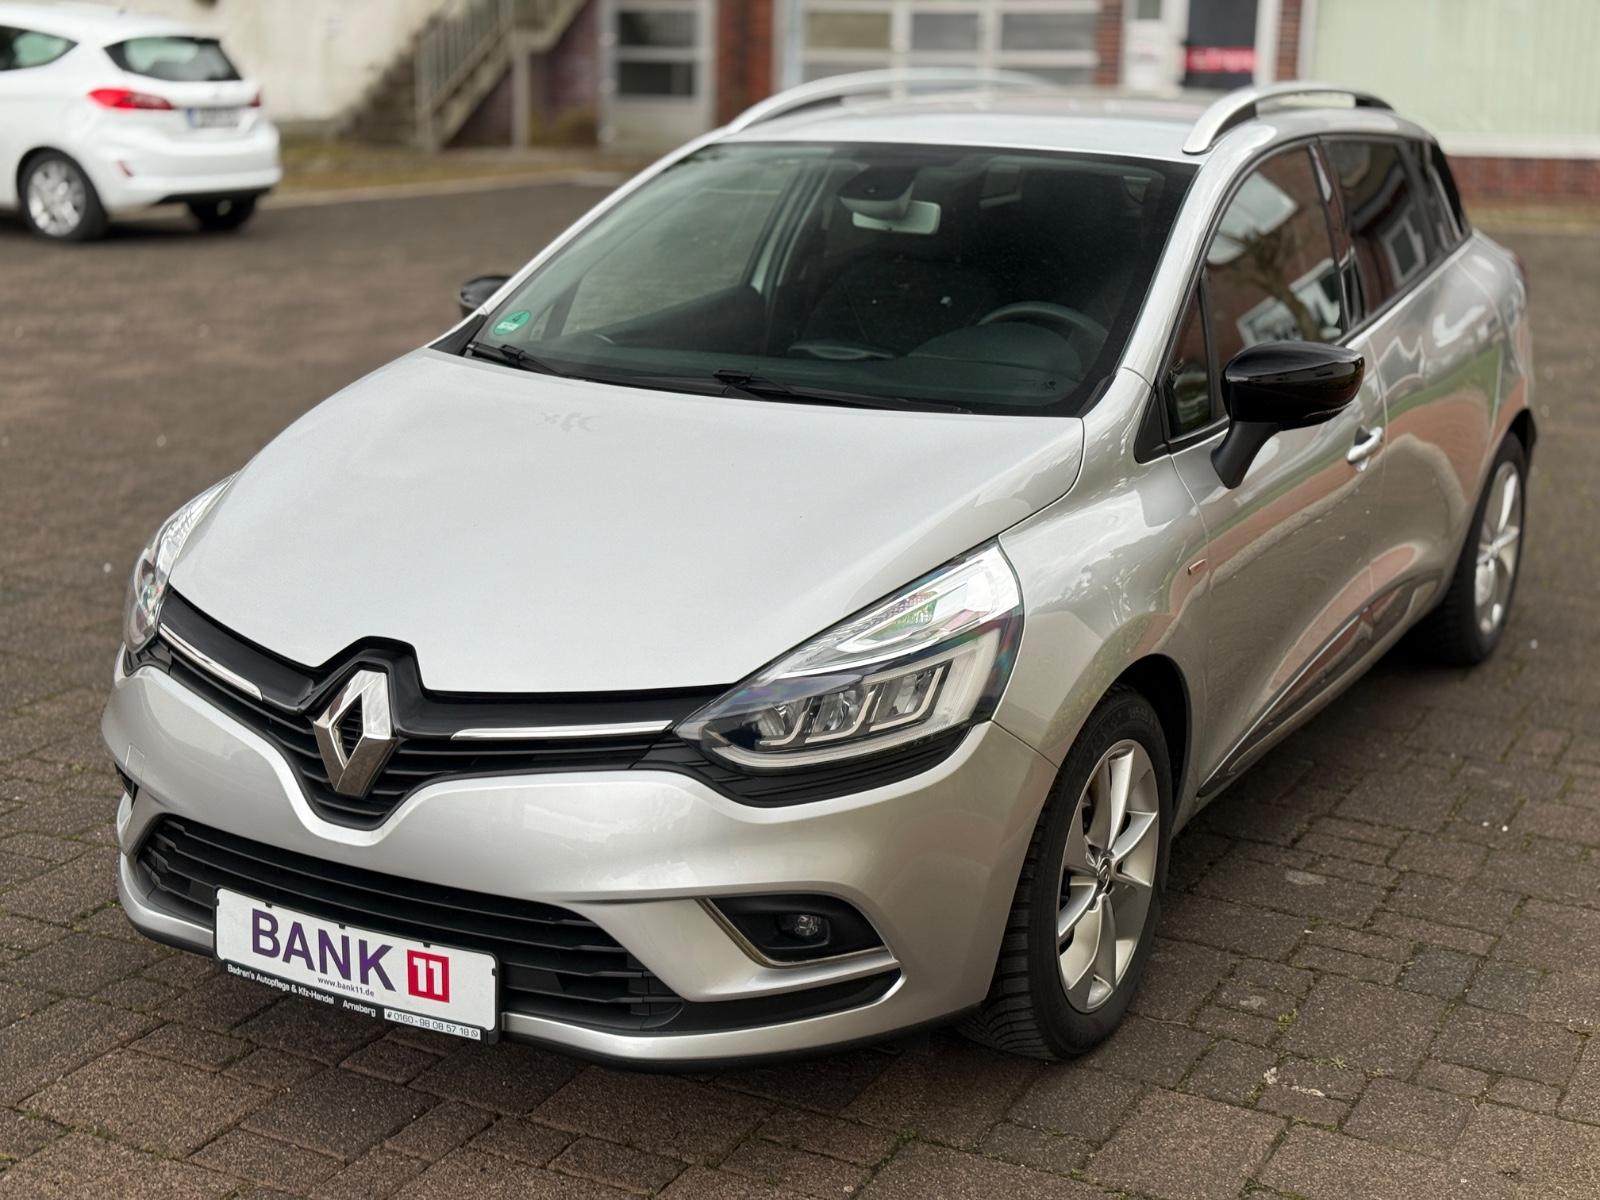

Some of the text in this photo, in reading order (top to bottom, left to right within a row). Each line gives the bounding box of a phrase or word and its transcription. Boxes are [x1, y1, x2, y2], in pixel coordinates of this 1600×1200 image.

[252, 908, 444, 996] BANK 11
[256, 973, 290, 991] Autopflege
[290, 984, 298, 994] &
[298, 986, 335, 1005] Kfz-Handel
[342, 999, 376, 1017] Arnsberg
[317, 976, 375, 997] www.bank11.de
[446, 1024, 457, 1033] 57
